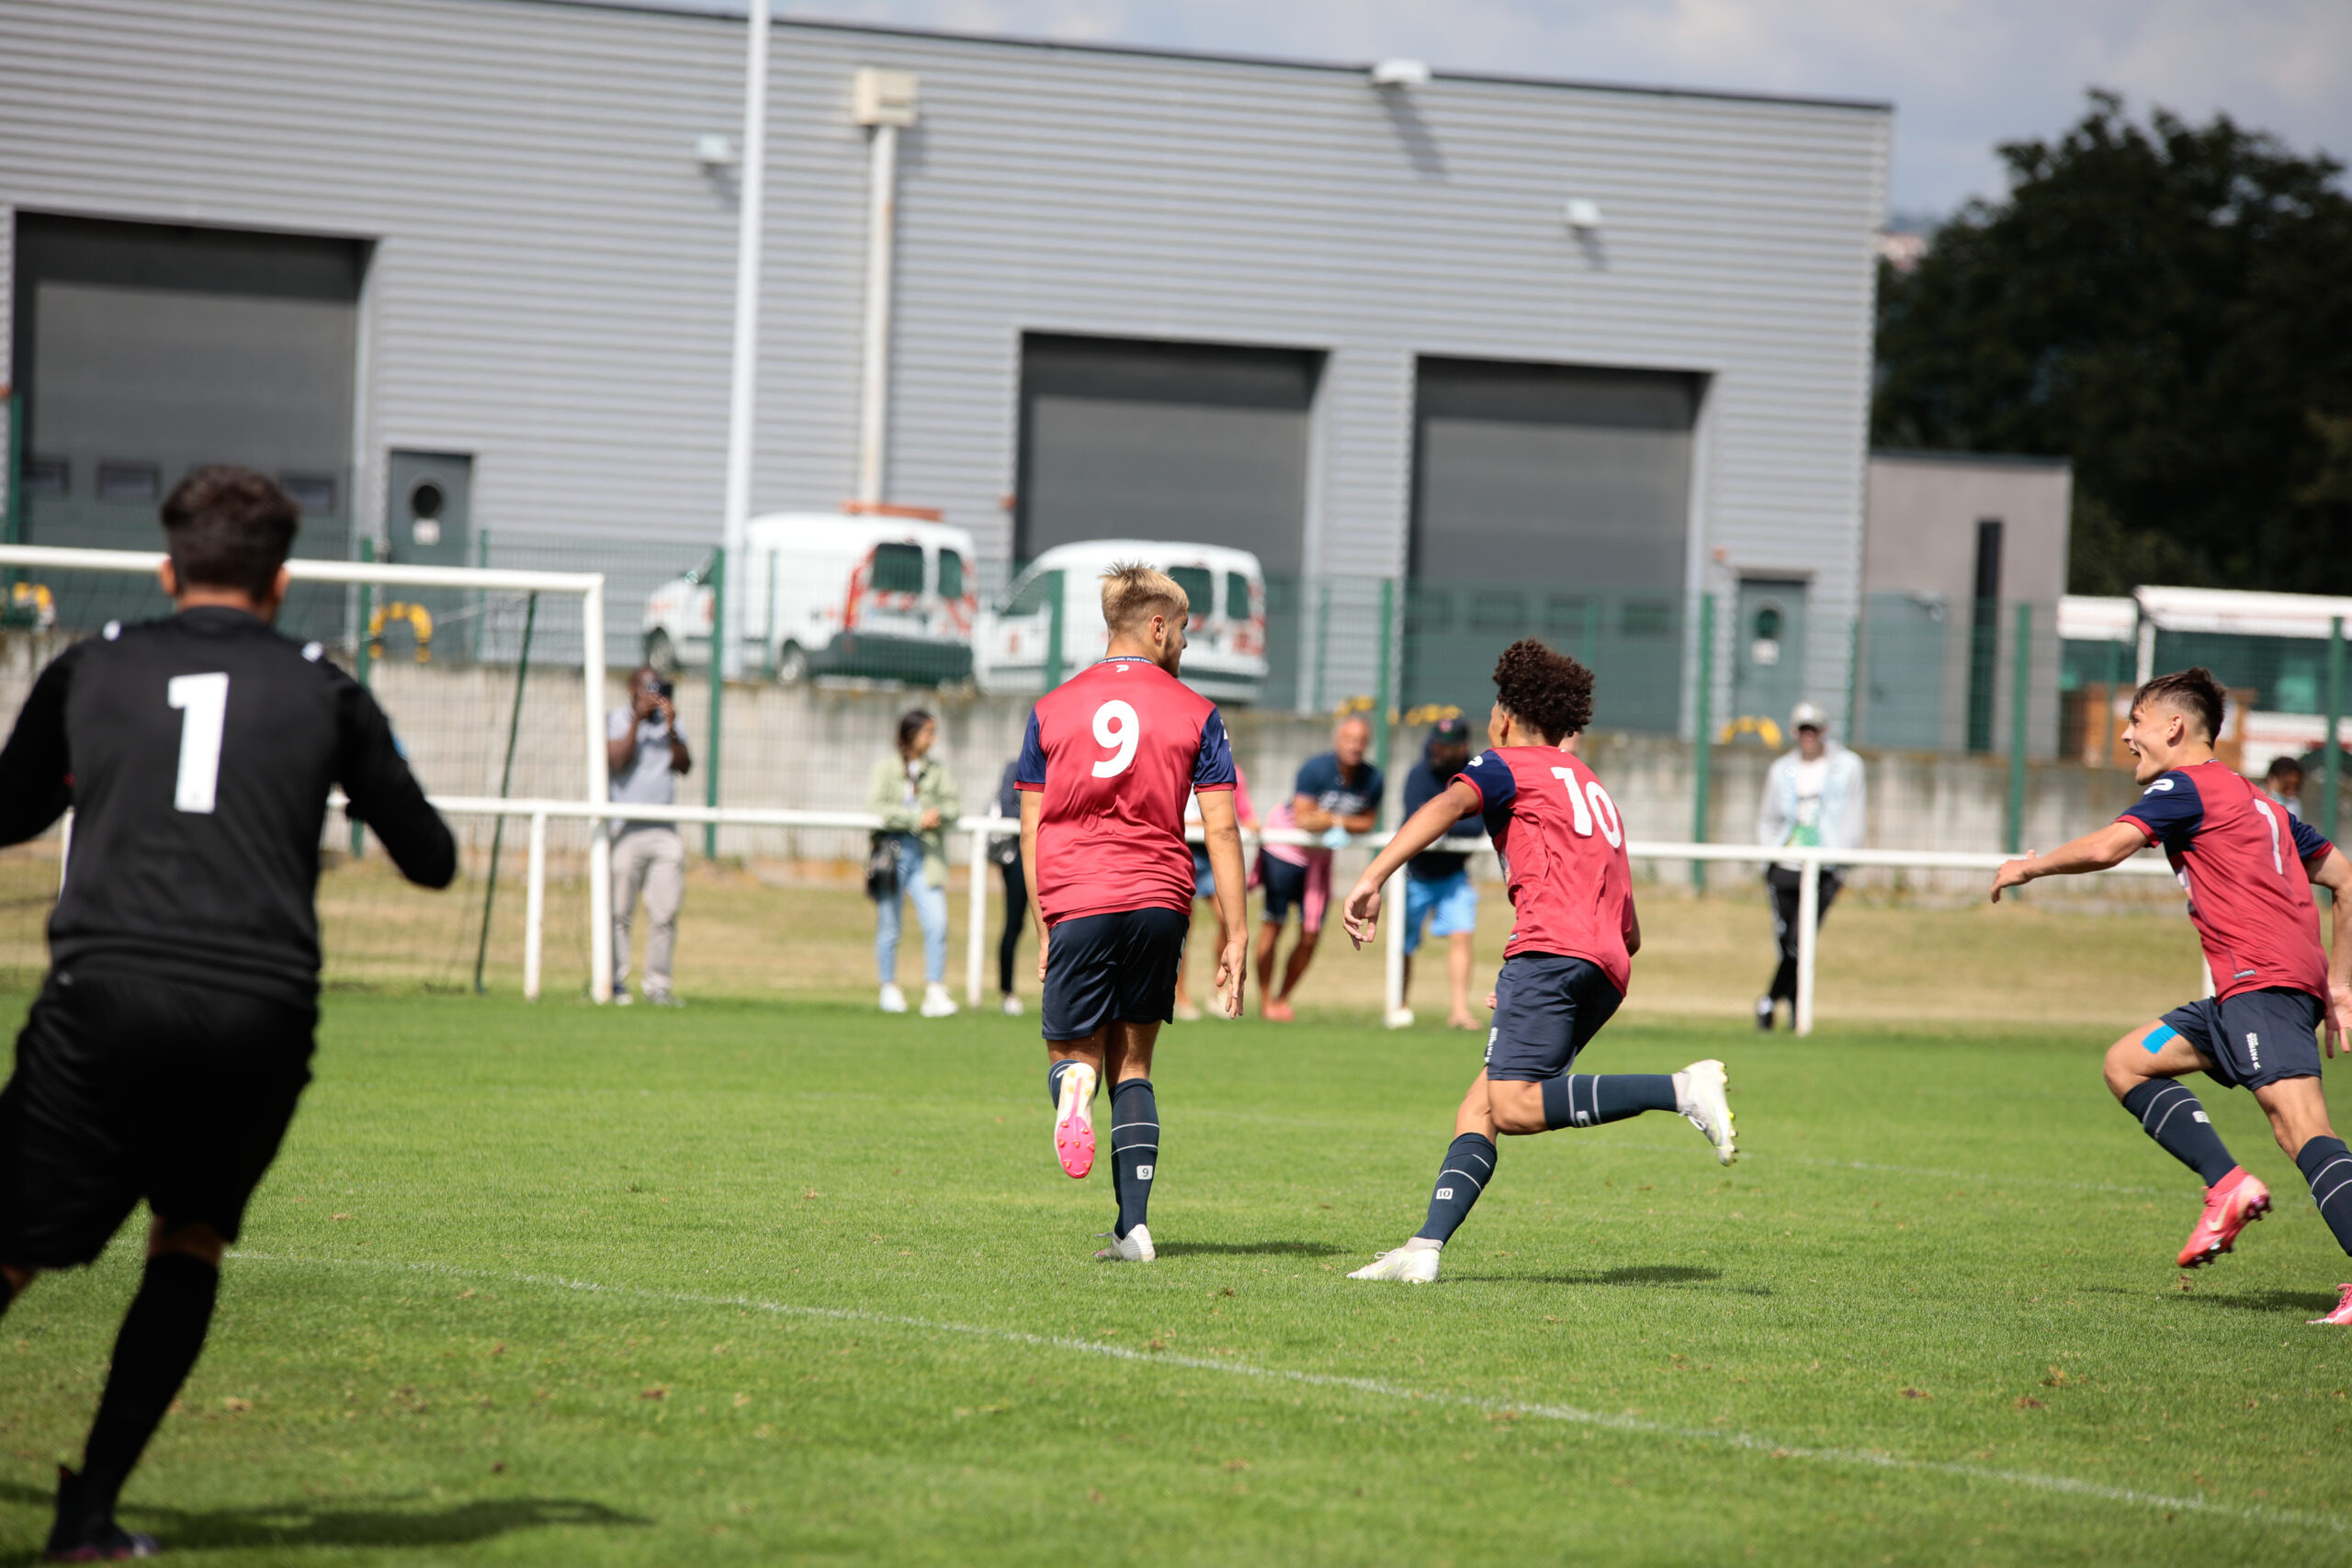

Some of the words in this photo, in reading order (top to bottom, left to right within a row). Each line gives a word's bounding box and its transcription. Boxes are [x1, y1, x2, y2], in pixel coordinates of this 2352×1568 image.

[167, 671, 230, 814] 1
[1091, 699, 1140, 779] 9
[1550, 766, 1623, 849] 10
[1142, 1168, 1149, 1178] 9
[1439, 1190, 1451, 1198] 10
